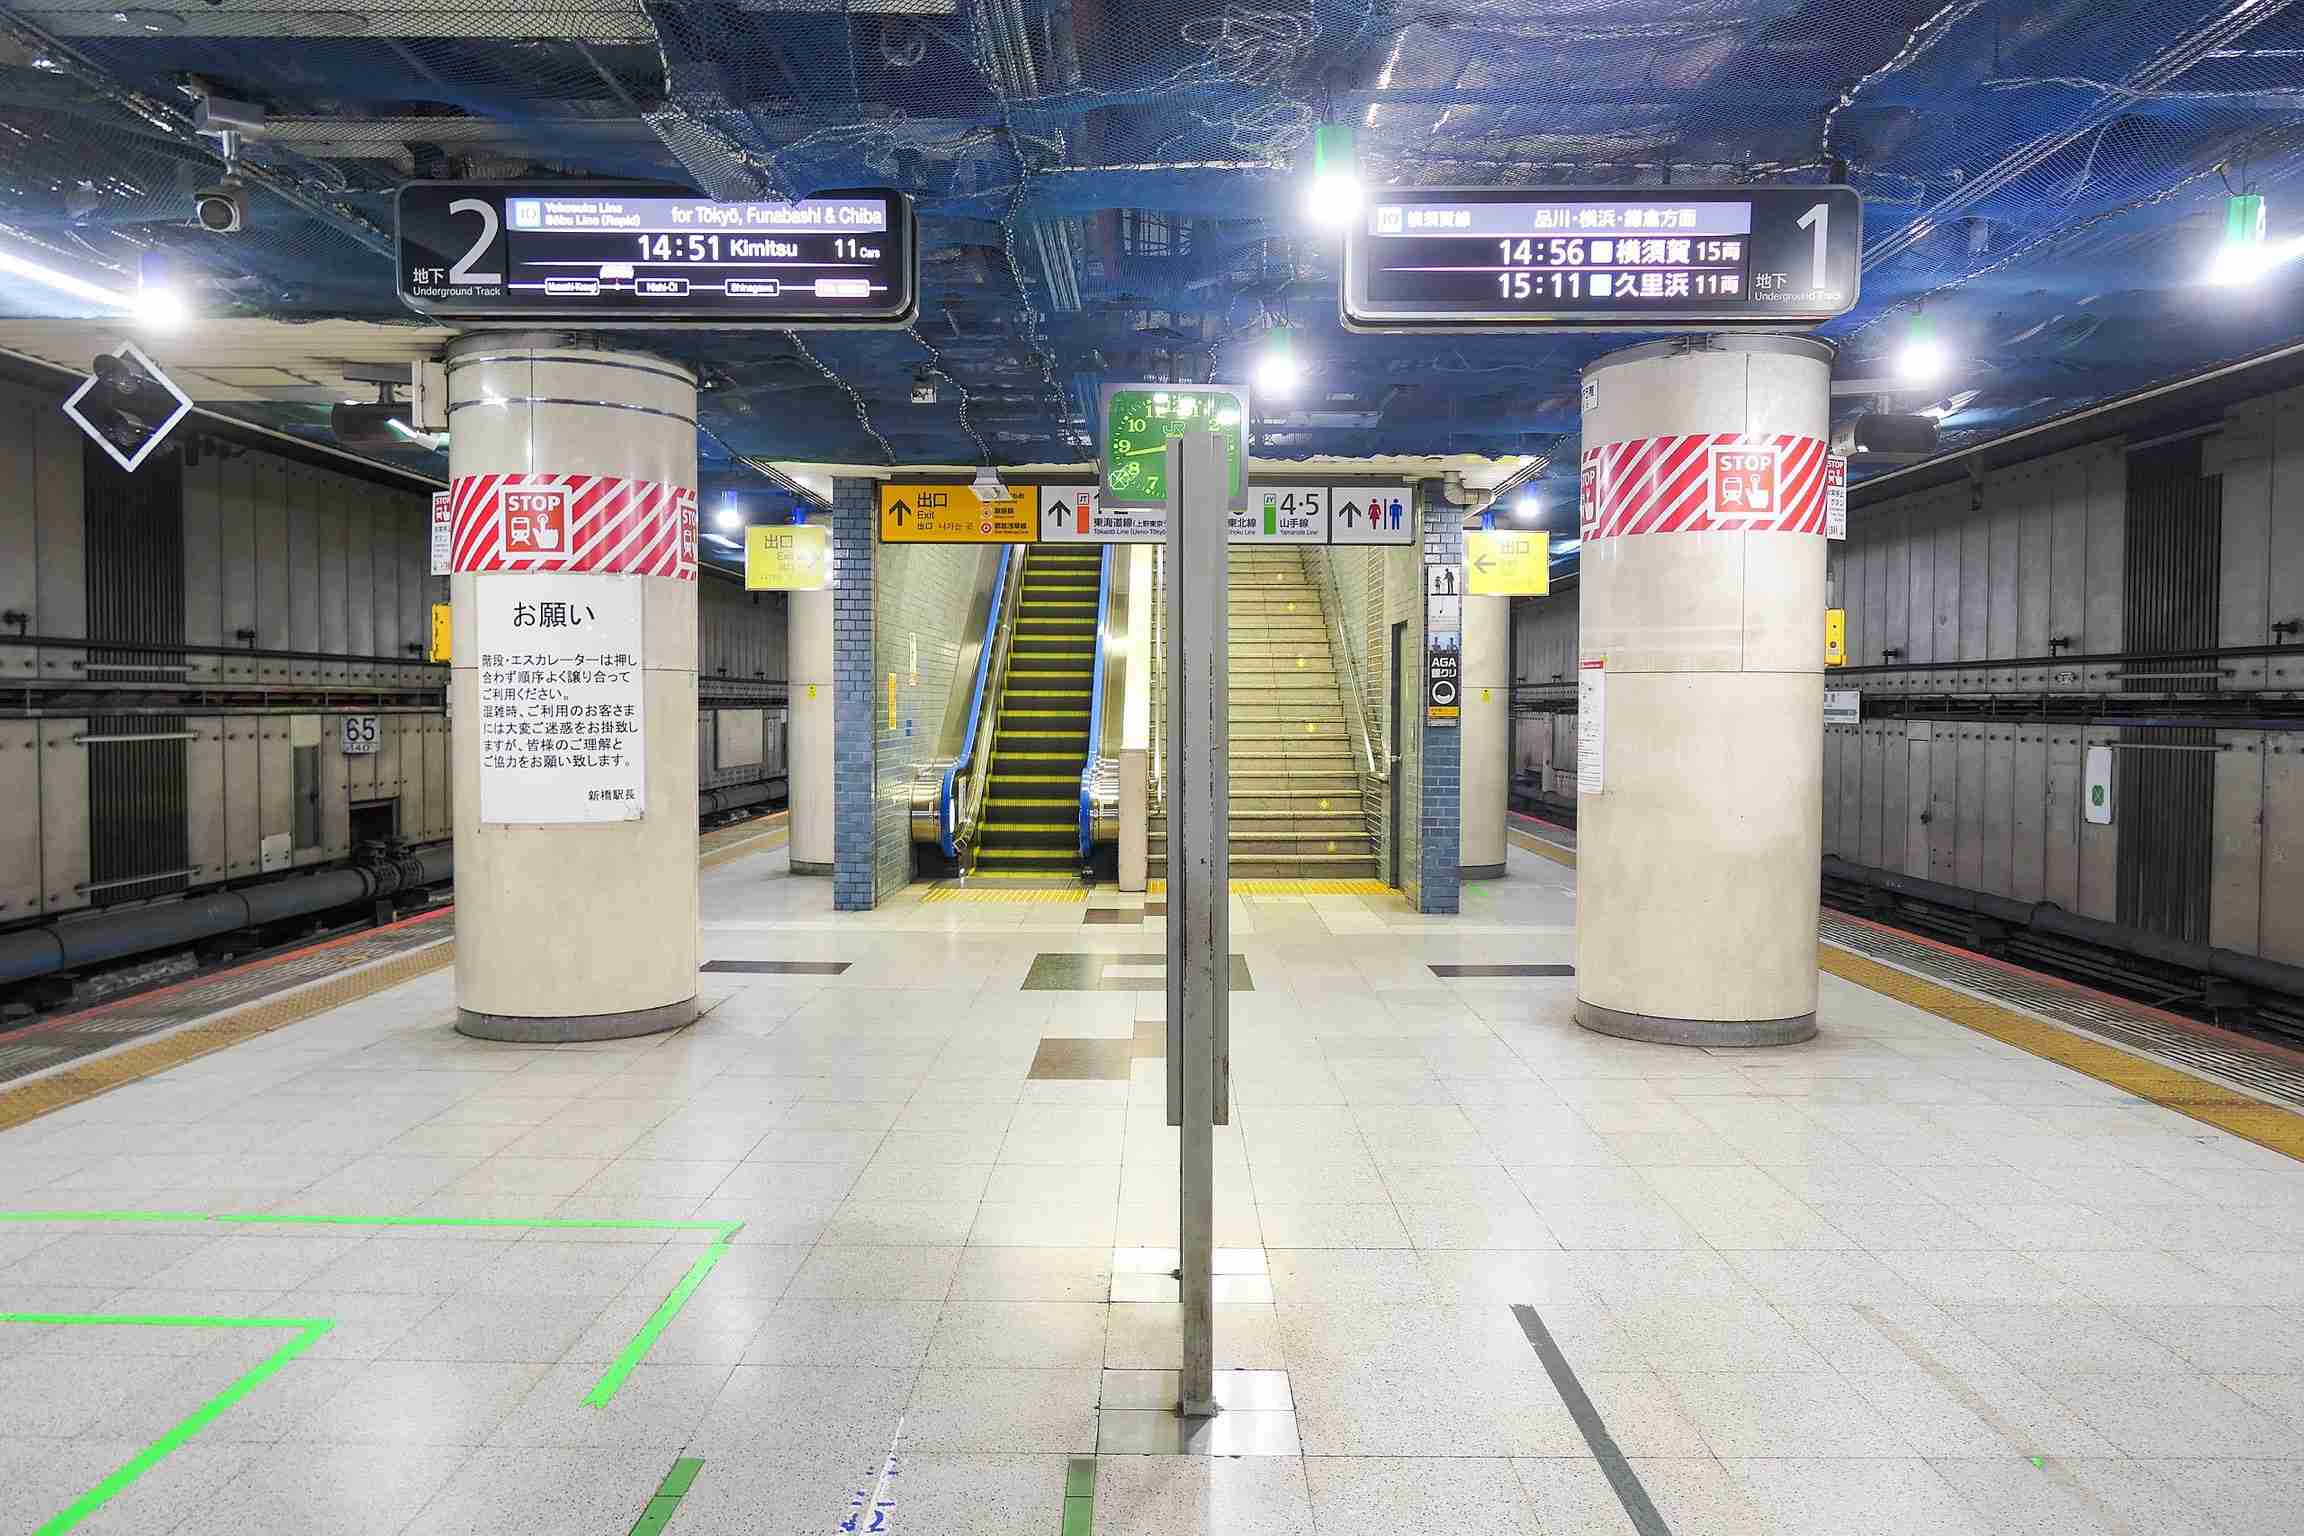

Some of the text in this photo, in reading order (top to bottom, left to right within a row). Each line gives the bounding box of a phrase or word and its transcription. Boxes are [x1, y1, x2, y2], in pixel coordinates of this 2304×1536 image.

[671, 206, 693, 223] for
[746, 206, 821, 224] Funabashi
[825, 206, 835, 224] &
[839, 206, 882, 224] Chiba
[449, 198, 501, 284] 2
[638, 234, 881, 261] 14:51 Kimitsu 11 Cars
[1796, 203, 1829, 289] 1
[1499, 238, 1741, 265] 14:56 横須賀 15両
[413, 267, 444, 284] 地下
[1755, 272, 1788, 289] 地下
[413, 286, 501, 298] Underground Track
[1498, 272, 1740, 298] 15:11 久里浜 11両
[1127, 418, 1146, 433] 10
[1118, 439, 1131, 453] 9
[1720, 455, 1771, 471] STOP
[1146, 476, 1158, 492] 7
[508, 494, 561, 512] STOP
[917, 491, 947, 507] 出口
[917, 510, 935, 519] Exit
[1280, 518, 1309, 528] 山手線
[764, 534, 793, 549] 出口
[1500, 540, 1529, 554] 出口
[513, 601, 596, 628] お願い
[481, 653, 638, 668] 階段・エスカレーターは押し
[1432, 656, 1457, 668] AGA
[482, 670, 631, 684] 合わず順序よく譲り合って
[482, 687, 569, 701] ご利用ください。
[346, 717, 375, 741] 65
[482, 738, 623, 752] ますが、皆様のご理解と
[482, 754, 631, 769] ご協力をお願い致します。
[588, 789, 635, 801] 新橋駅長
